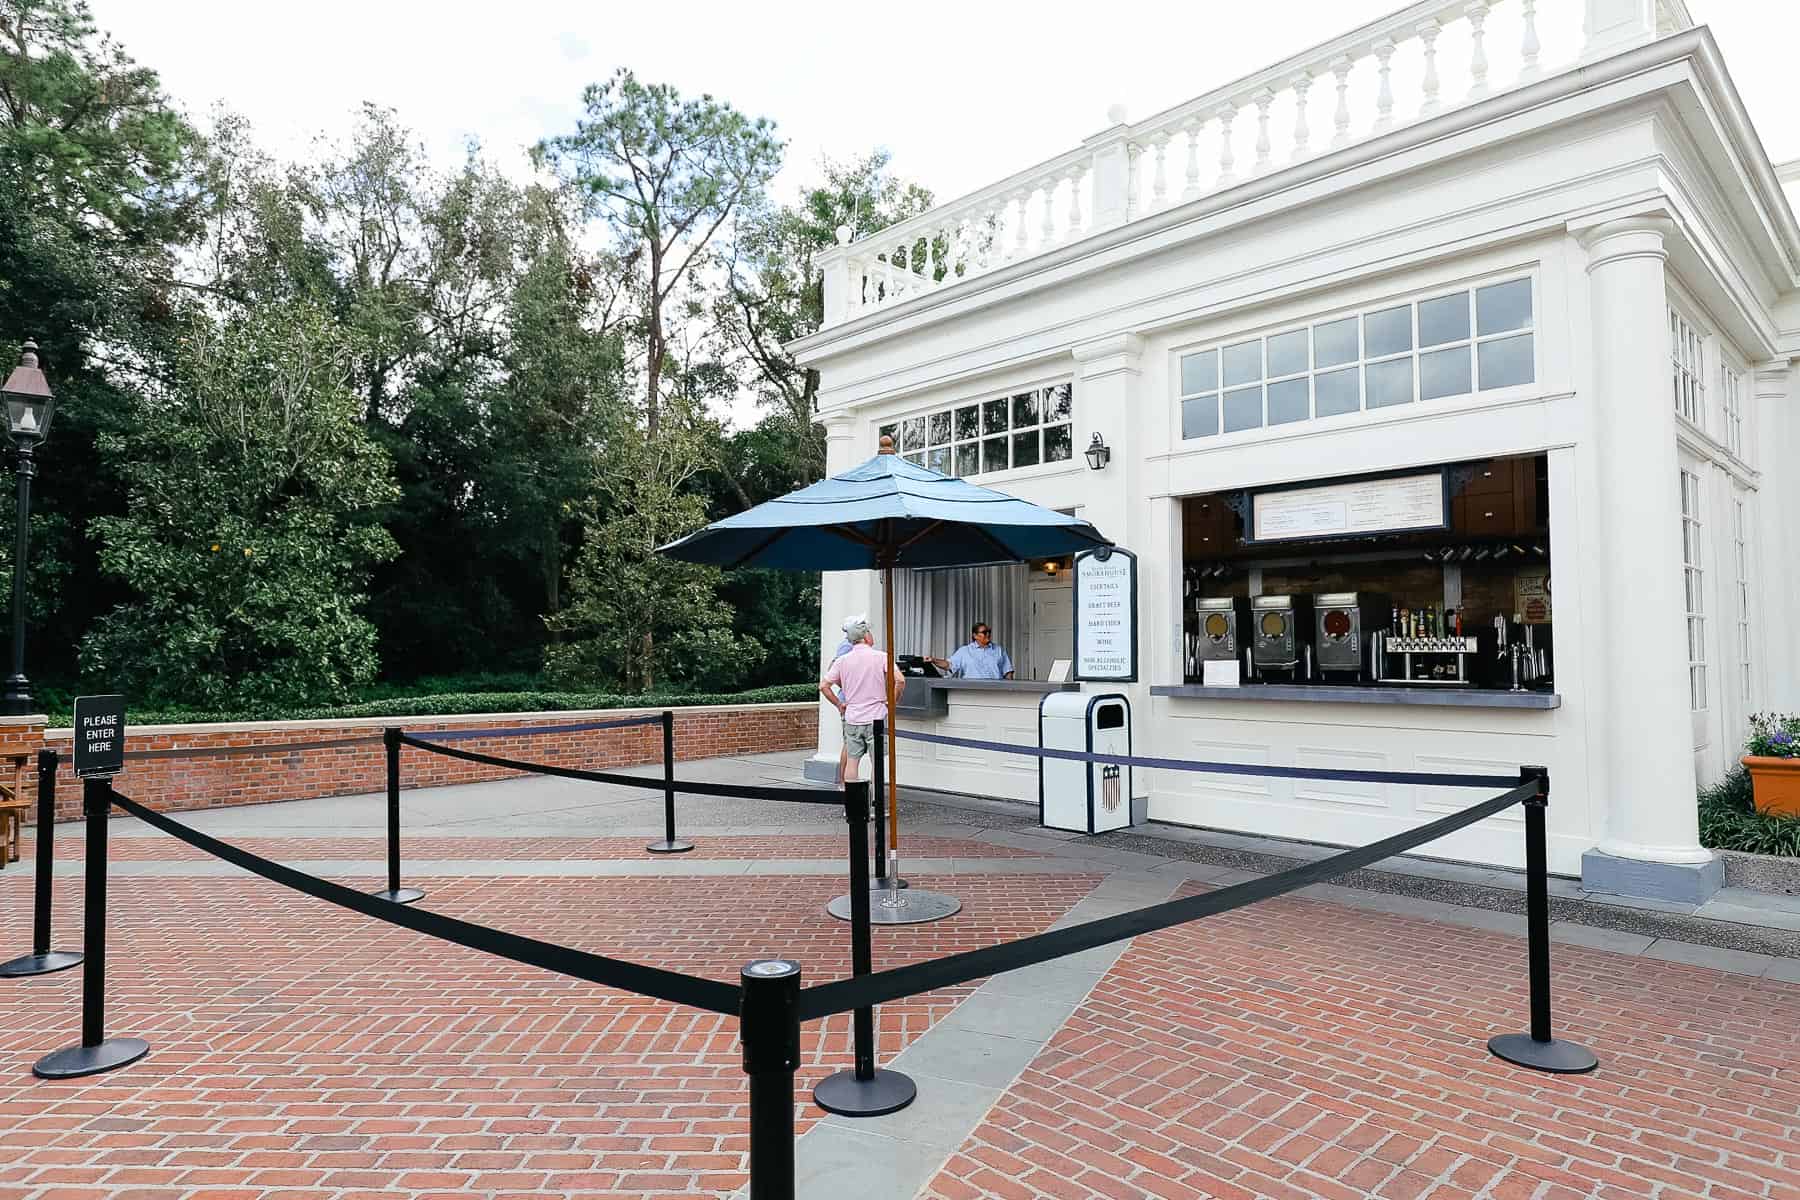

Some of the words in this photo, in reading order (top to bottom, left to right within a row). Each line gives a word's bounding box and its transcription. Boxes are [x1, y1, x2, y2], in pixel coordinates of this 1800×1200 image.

[83, 715, 117, 727] PLEASE
[86, 728, 115, 740] ENTER
[88, 742, 112, 752] HERE
